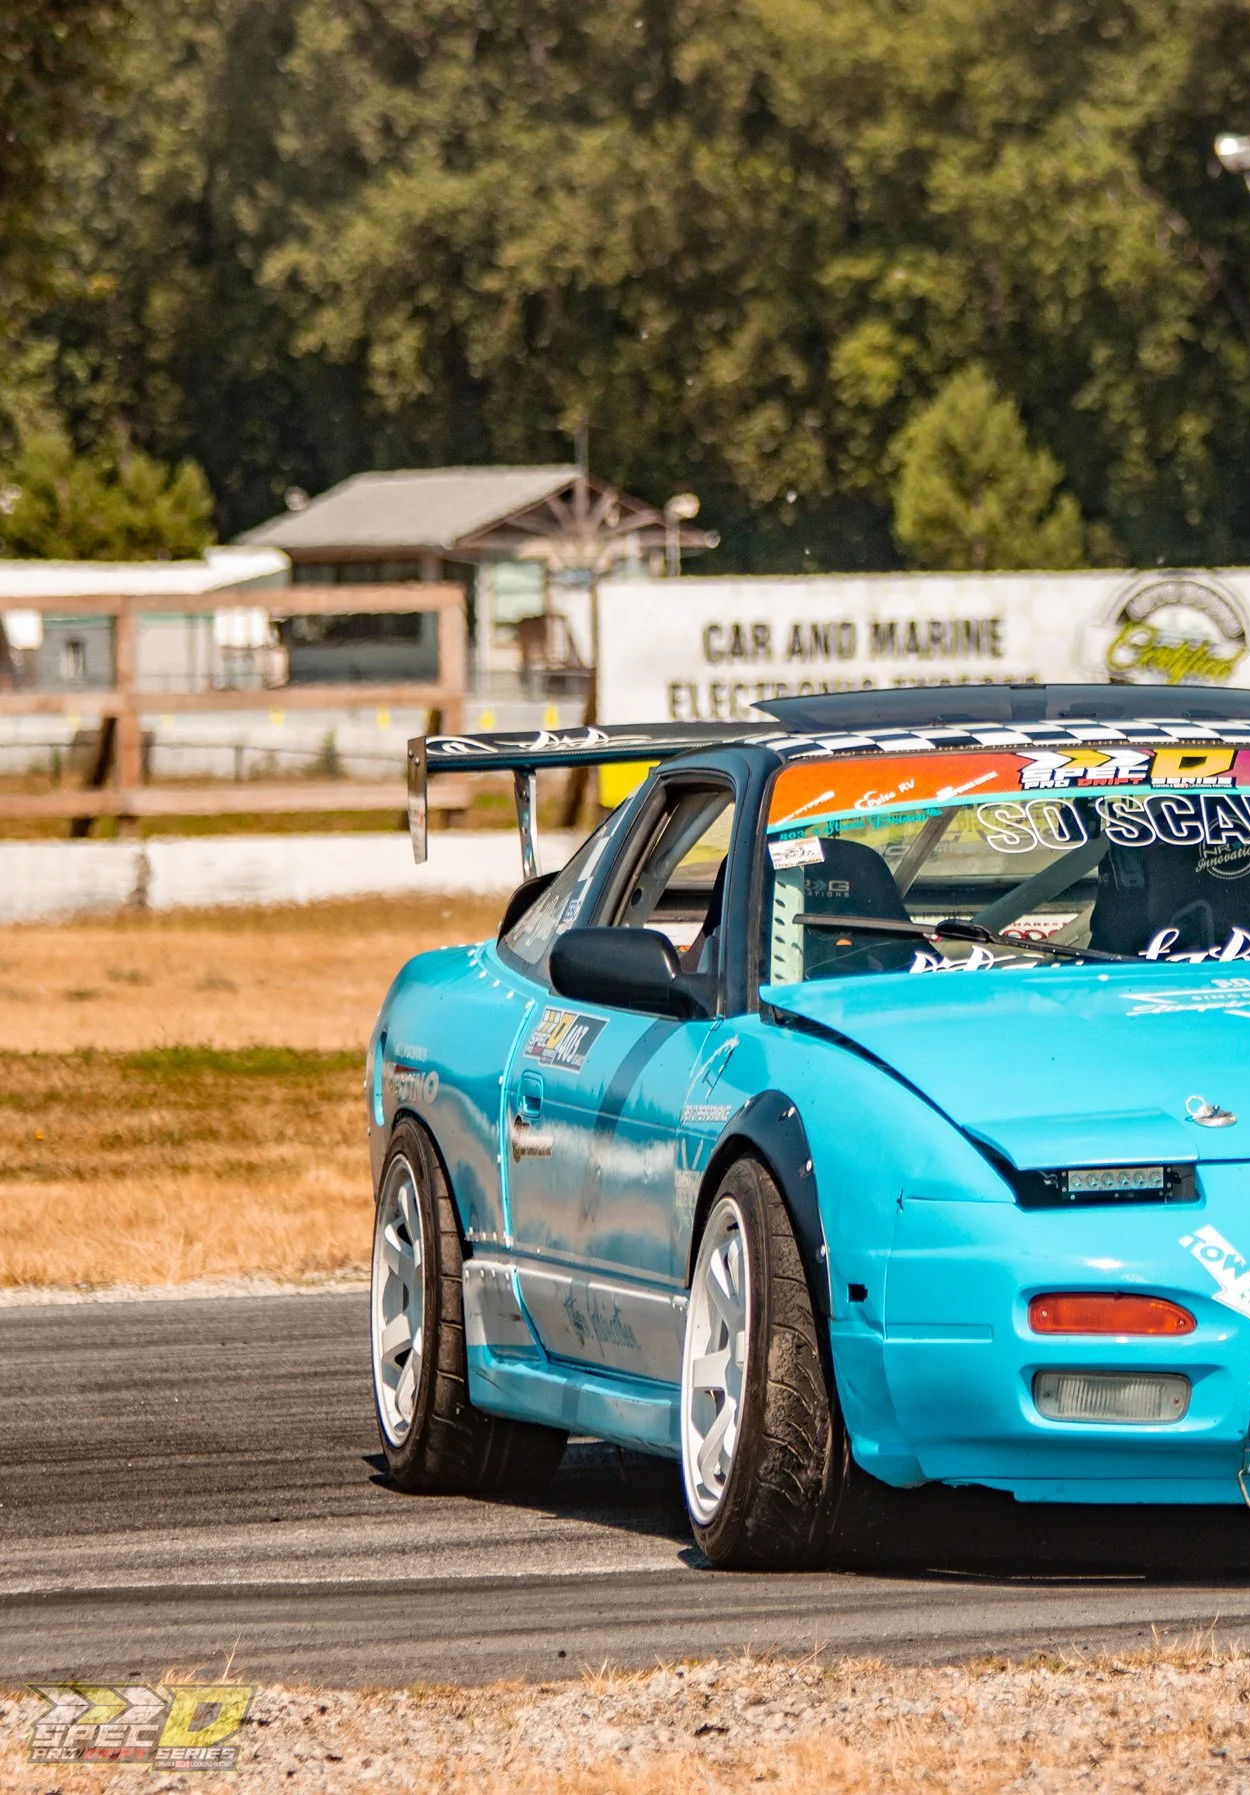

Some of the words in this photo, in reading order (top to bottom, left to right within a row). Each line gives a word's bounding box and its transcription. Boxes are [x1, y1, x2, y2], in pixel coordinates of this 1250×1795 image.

[702, 620, 772, 664] CAR
[788, 618, 857, 663] AND
[870, 615, 1006, 663] MARINE
[898, 779, 915, 794] RV
[1021, 765, 1149, 780] SPEC
[1023, 780, 1070, 789] PRO
[976, 798, 1089, 853] SO
[1186, 1232, 1250, 1281] TOW
